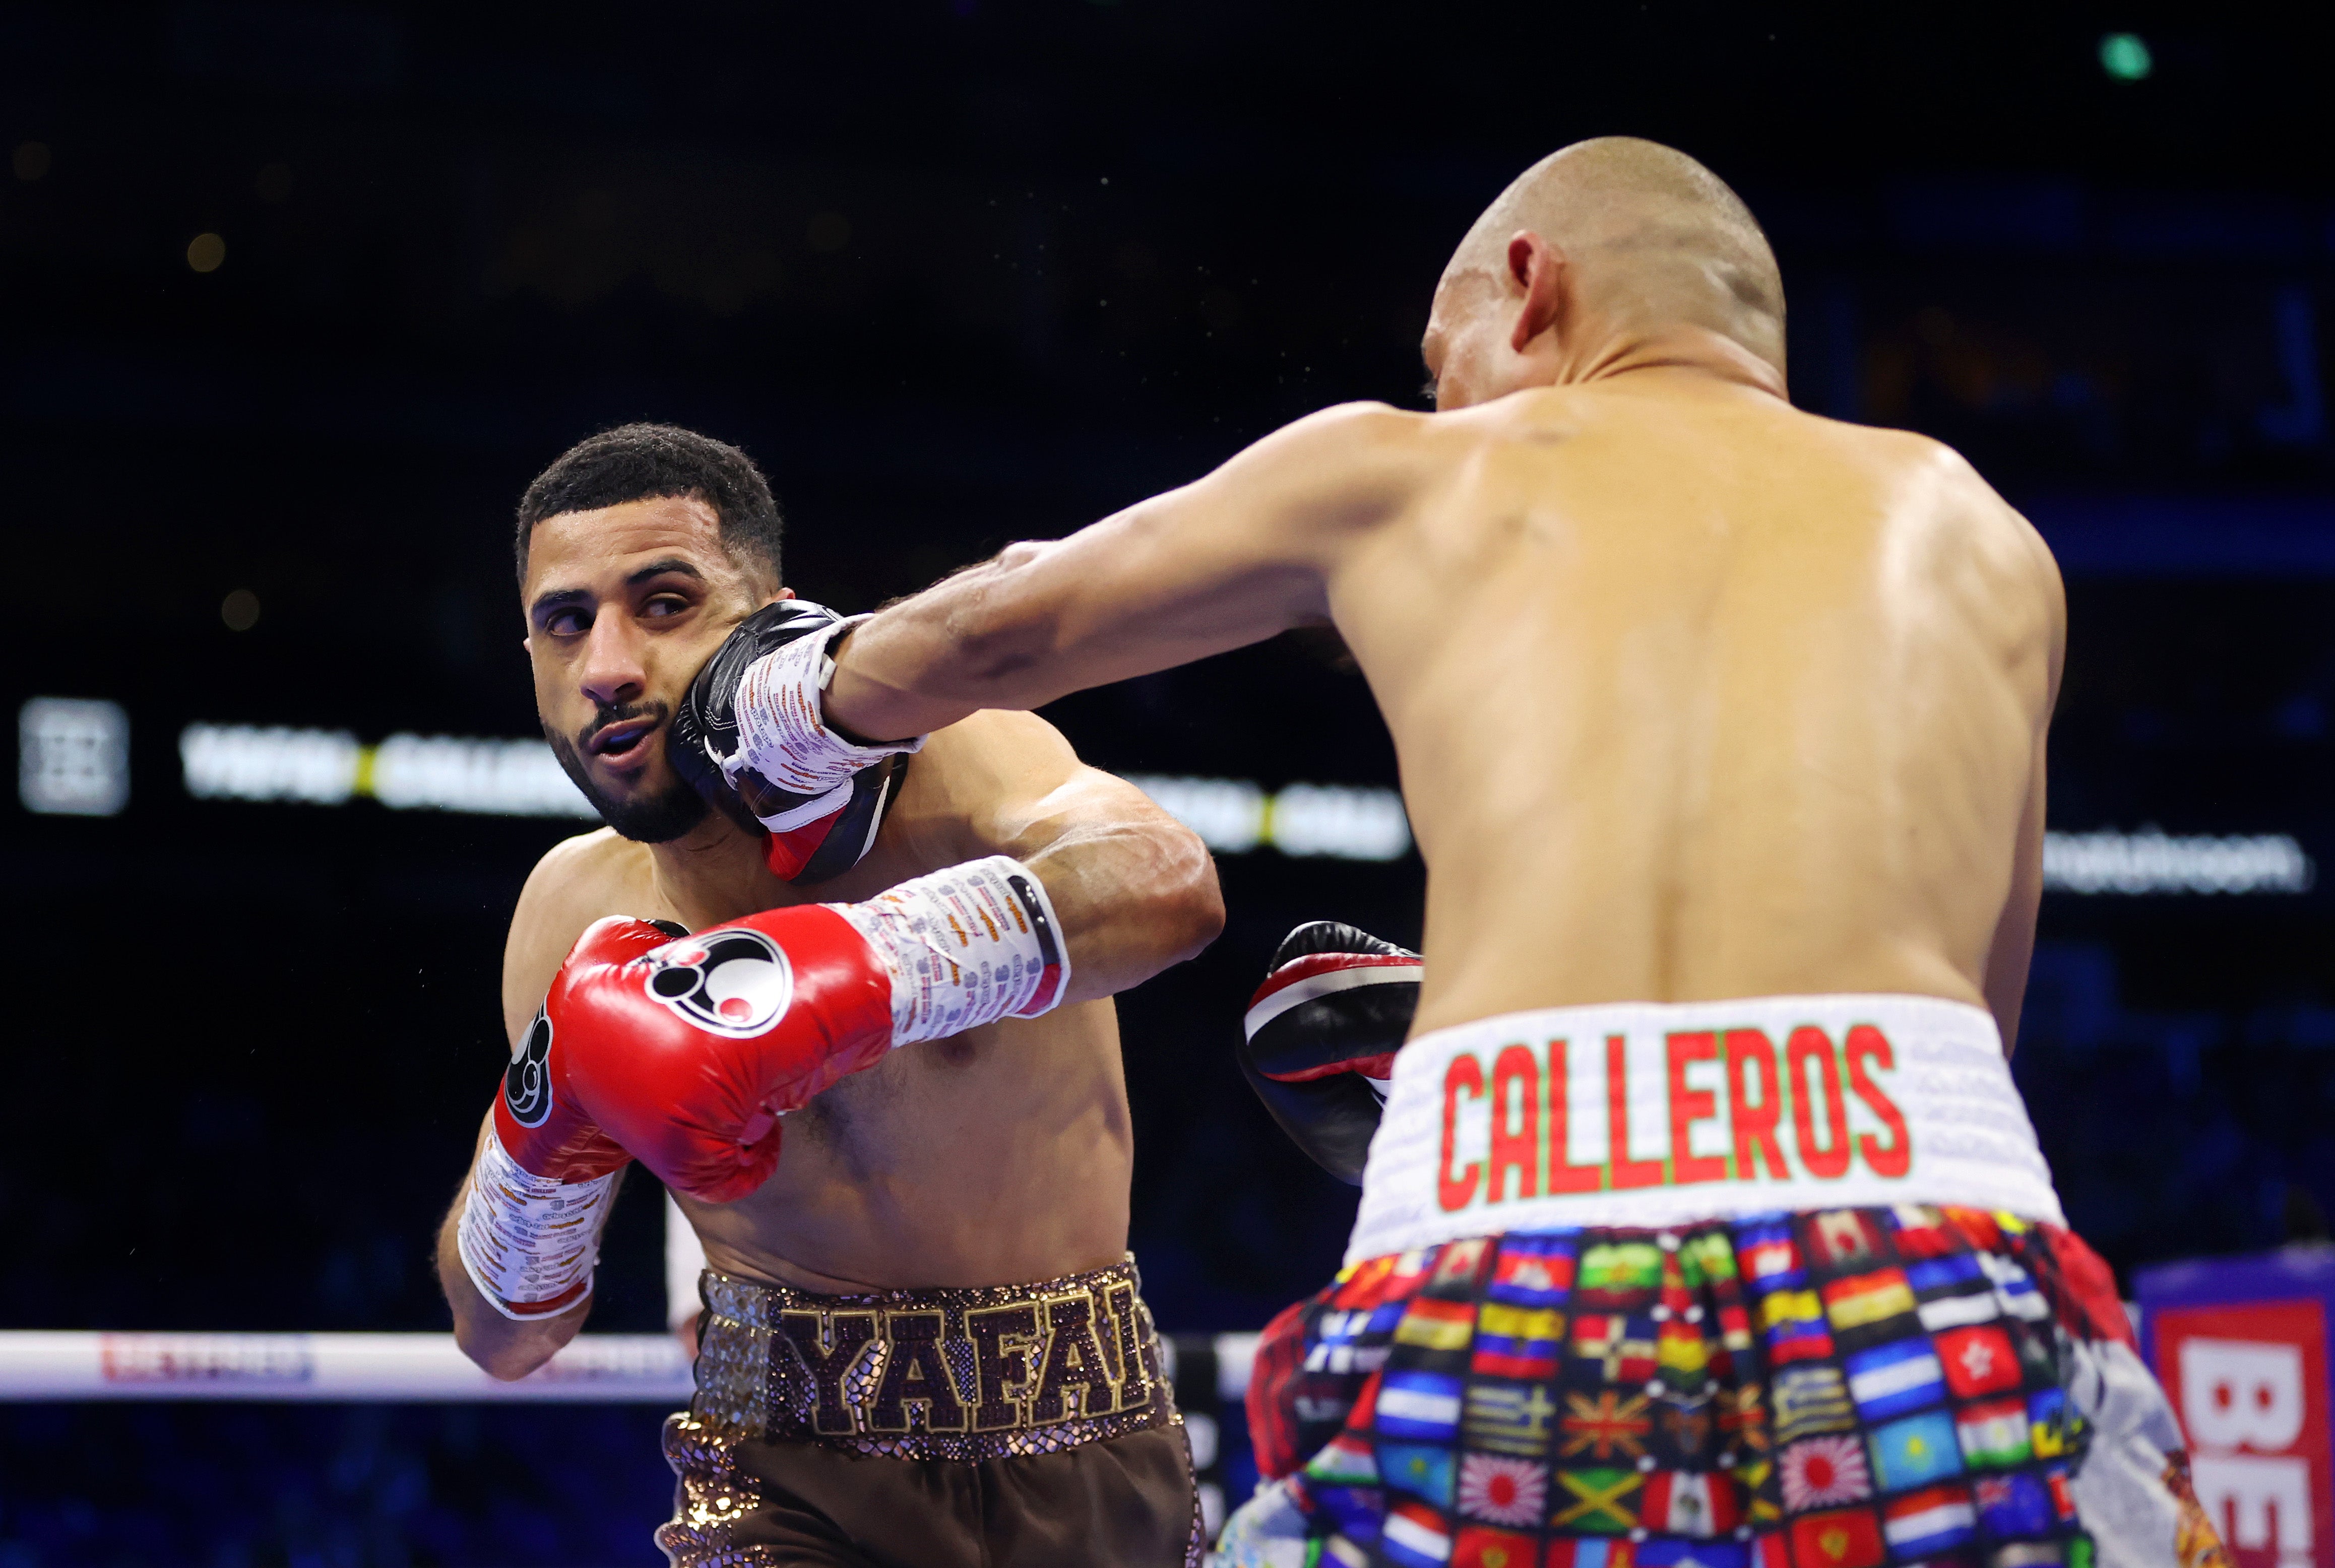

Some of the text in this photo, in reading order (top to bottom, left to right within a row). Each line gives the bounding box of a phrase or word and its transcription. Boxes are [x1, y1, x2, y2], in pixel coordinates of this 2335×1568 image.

[1436, 1023, 1912, 1212] CALLEROS
[780, 1278, 1150, 1436] YAFAI
[2176, 1334, 2318, 1568] BE
